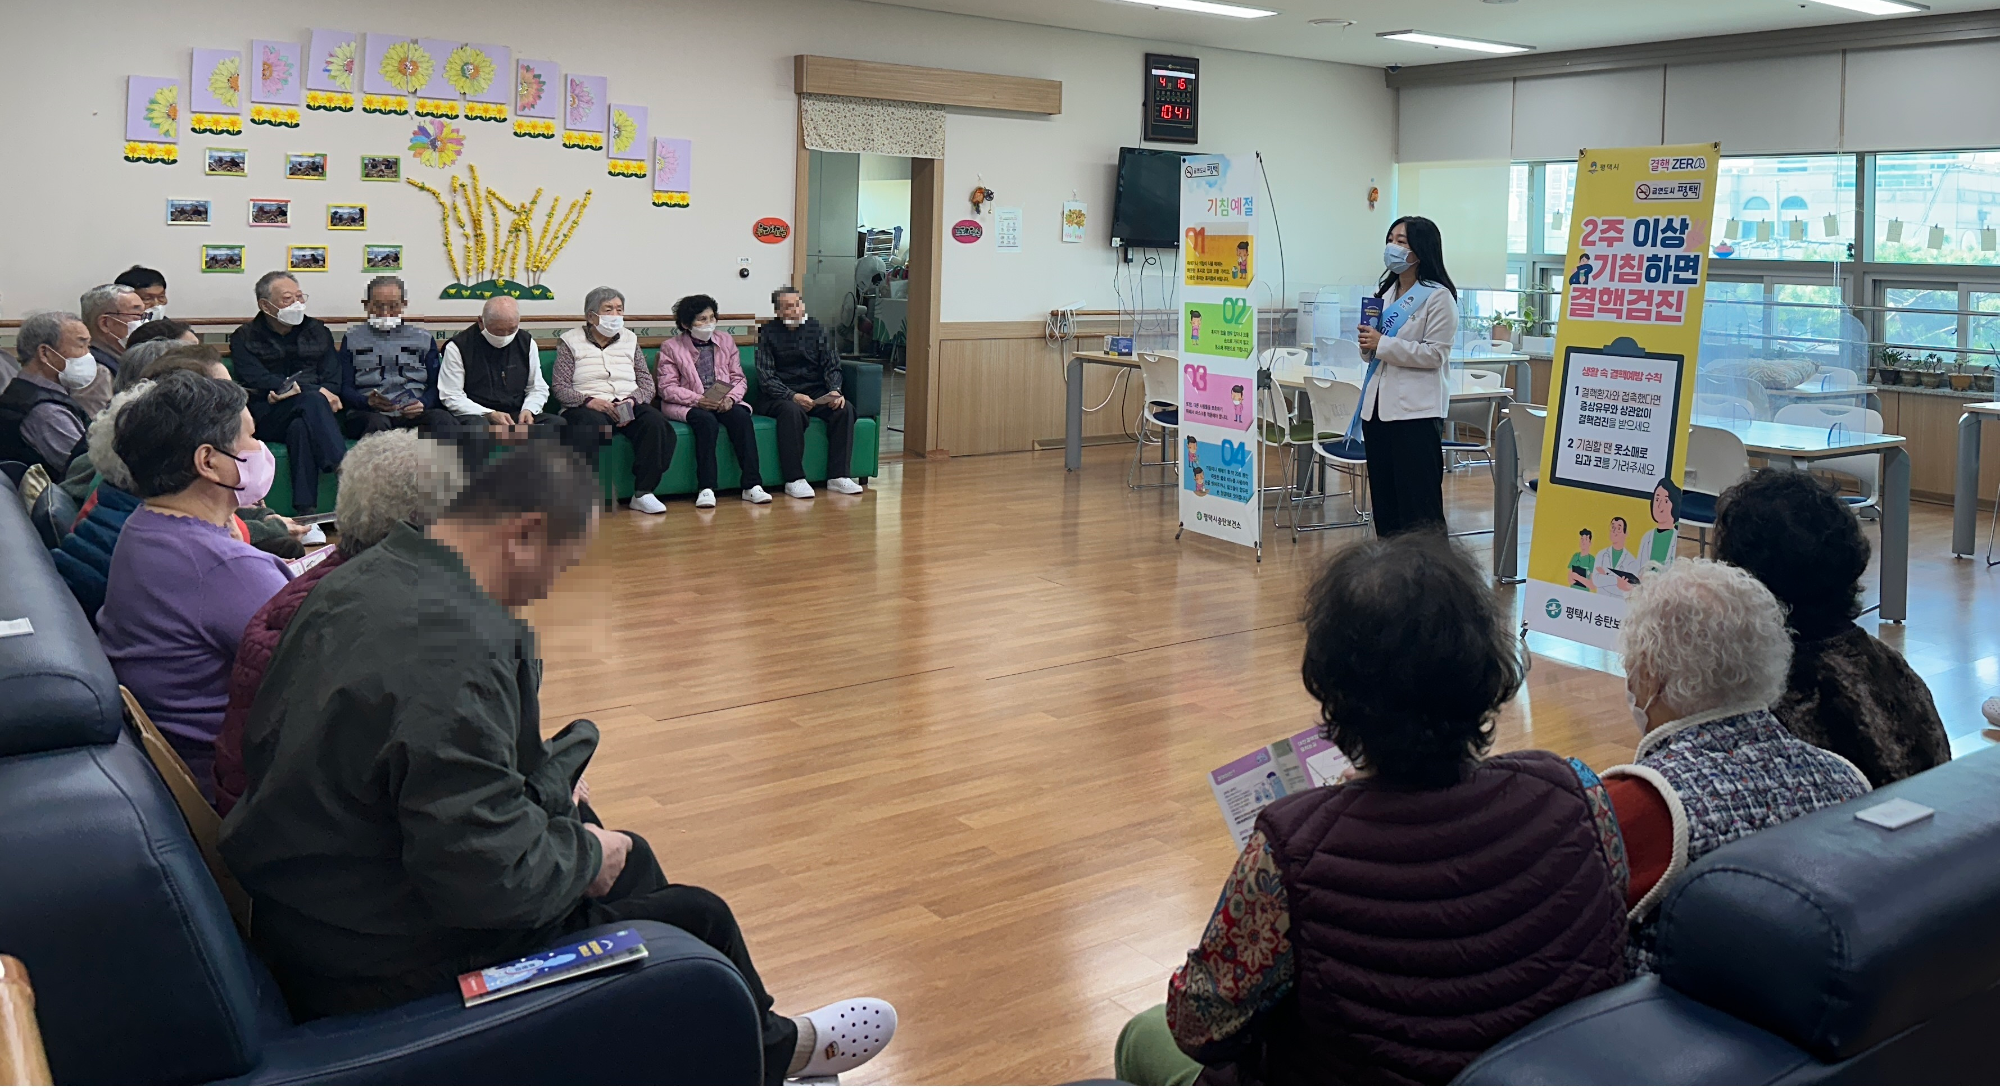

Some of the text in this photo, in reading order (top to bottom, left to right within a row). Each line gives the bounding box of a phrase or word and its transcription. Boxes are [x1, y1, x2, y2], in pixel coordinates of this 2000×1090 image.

[1159, 76, 1167, 87] 4
[1650, 158, 1670, 172] 결핵
[1652, 184, 1699, 198] 금연도시 평택
[1207, 196, 1254, 217] 기침예절
[1185, 226, 1206, 254] 01
[1581, 217, 1690, 249] 2주 이상
[1591, 253, 1700, 285] 기침하면
[1223, 297, 1247, 325] 02
[1568, 287, 1685, 323] 결핵검진
[1184, 363, 1207, 391] 03
[1582, 366, 1663, 384] 생활 속 결핵예방 수칙
[1574, 385, 1662, 406] 1 결핵환자와 접촉했다면
[1580, 401, 1652, 420] 증상유무와 상관없이
[1578, 414, 1617, 429] 결핵검진을
[1221, 438, 1246, 468] 04
[1567, 438, 1649, 459] 2 기침할 땐 옷소매로
[1575, 453, 1592, 468] 입과
[1593, 456, 1610, 470] 코를
[1565, 606, 1593, 624] 평택시
